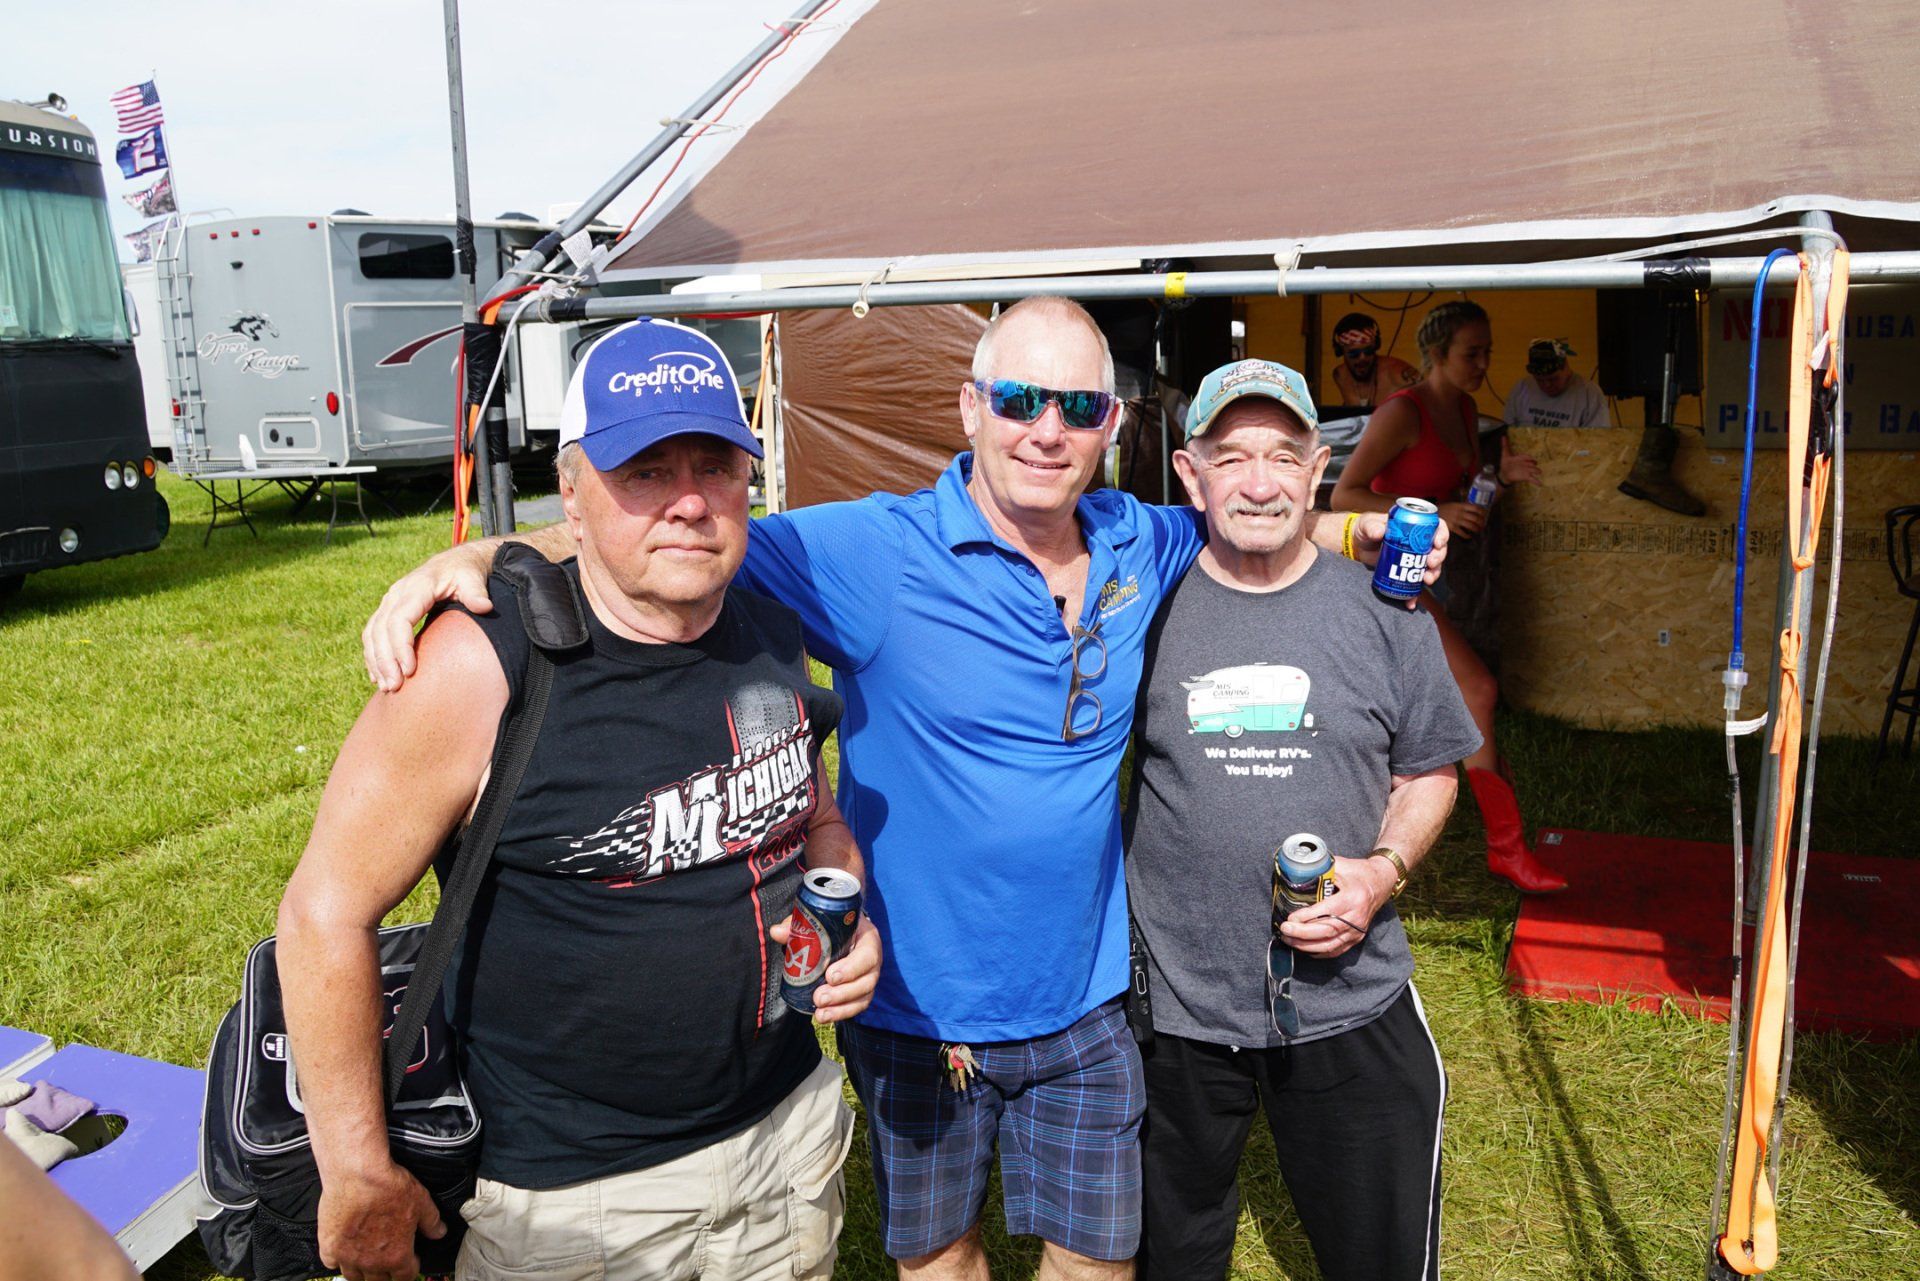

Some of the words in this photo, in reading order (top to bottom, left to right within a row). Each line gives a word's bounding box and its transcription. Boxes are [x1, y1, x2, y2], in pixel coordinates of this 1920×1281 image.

[7, 128, 96, 156] URSION
[197, 332, 250, 365] Open
[235, 348, 300, 379] Range
[608, 363, 724, 393] CreditOne
[635, 385, 700, 397] BANK
[1400, 552, 1428, 569] BU
[1388, 564, 1426, 583] LIG
[1204, 747, 1227, 758] We
[1229, 746, 1277, 758] Deliver
[1224, 764, 1250, 776] You
[1252, 763, 1293, 778] Enjoy!
[637, 734, 814, 879] MICHIGAN
